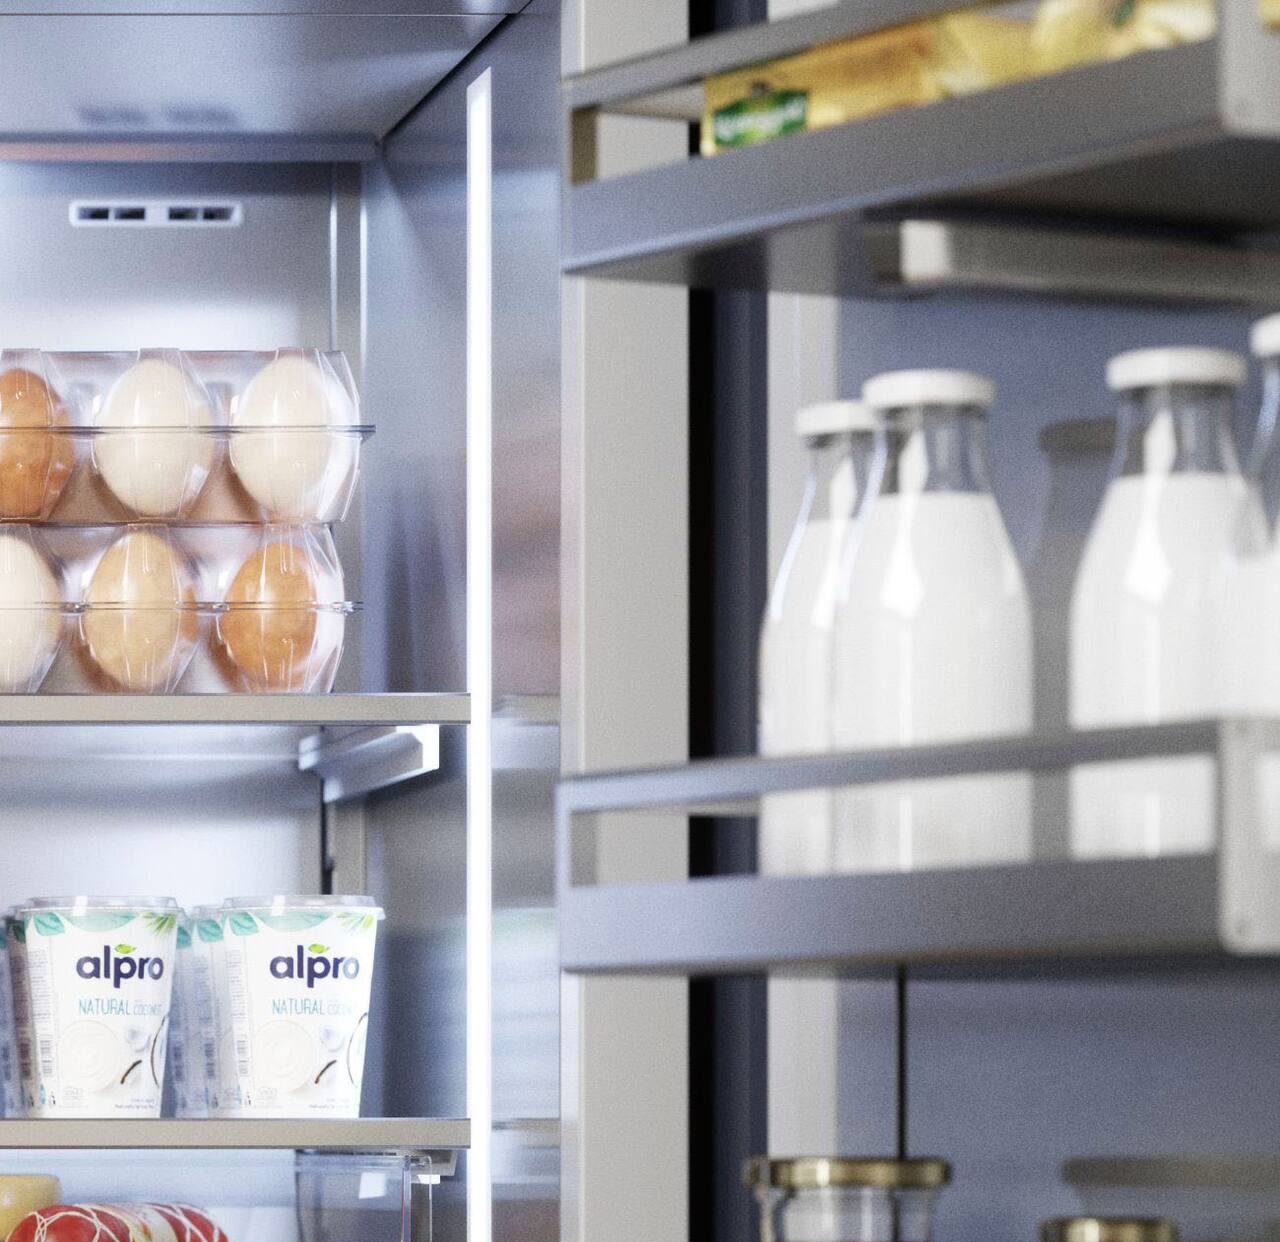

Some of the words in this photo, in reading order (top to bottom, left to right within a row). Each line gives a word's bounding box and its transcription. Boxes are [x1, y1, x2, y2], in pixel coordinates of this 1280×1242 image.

[76, 944, 164, 989] alpro
[269, 944, 360, 989] alpro
[79, 998, 131, 1016] NATURAL
[272, 998, 325, 1015] NATURAL
